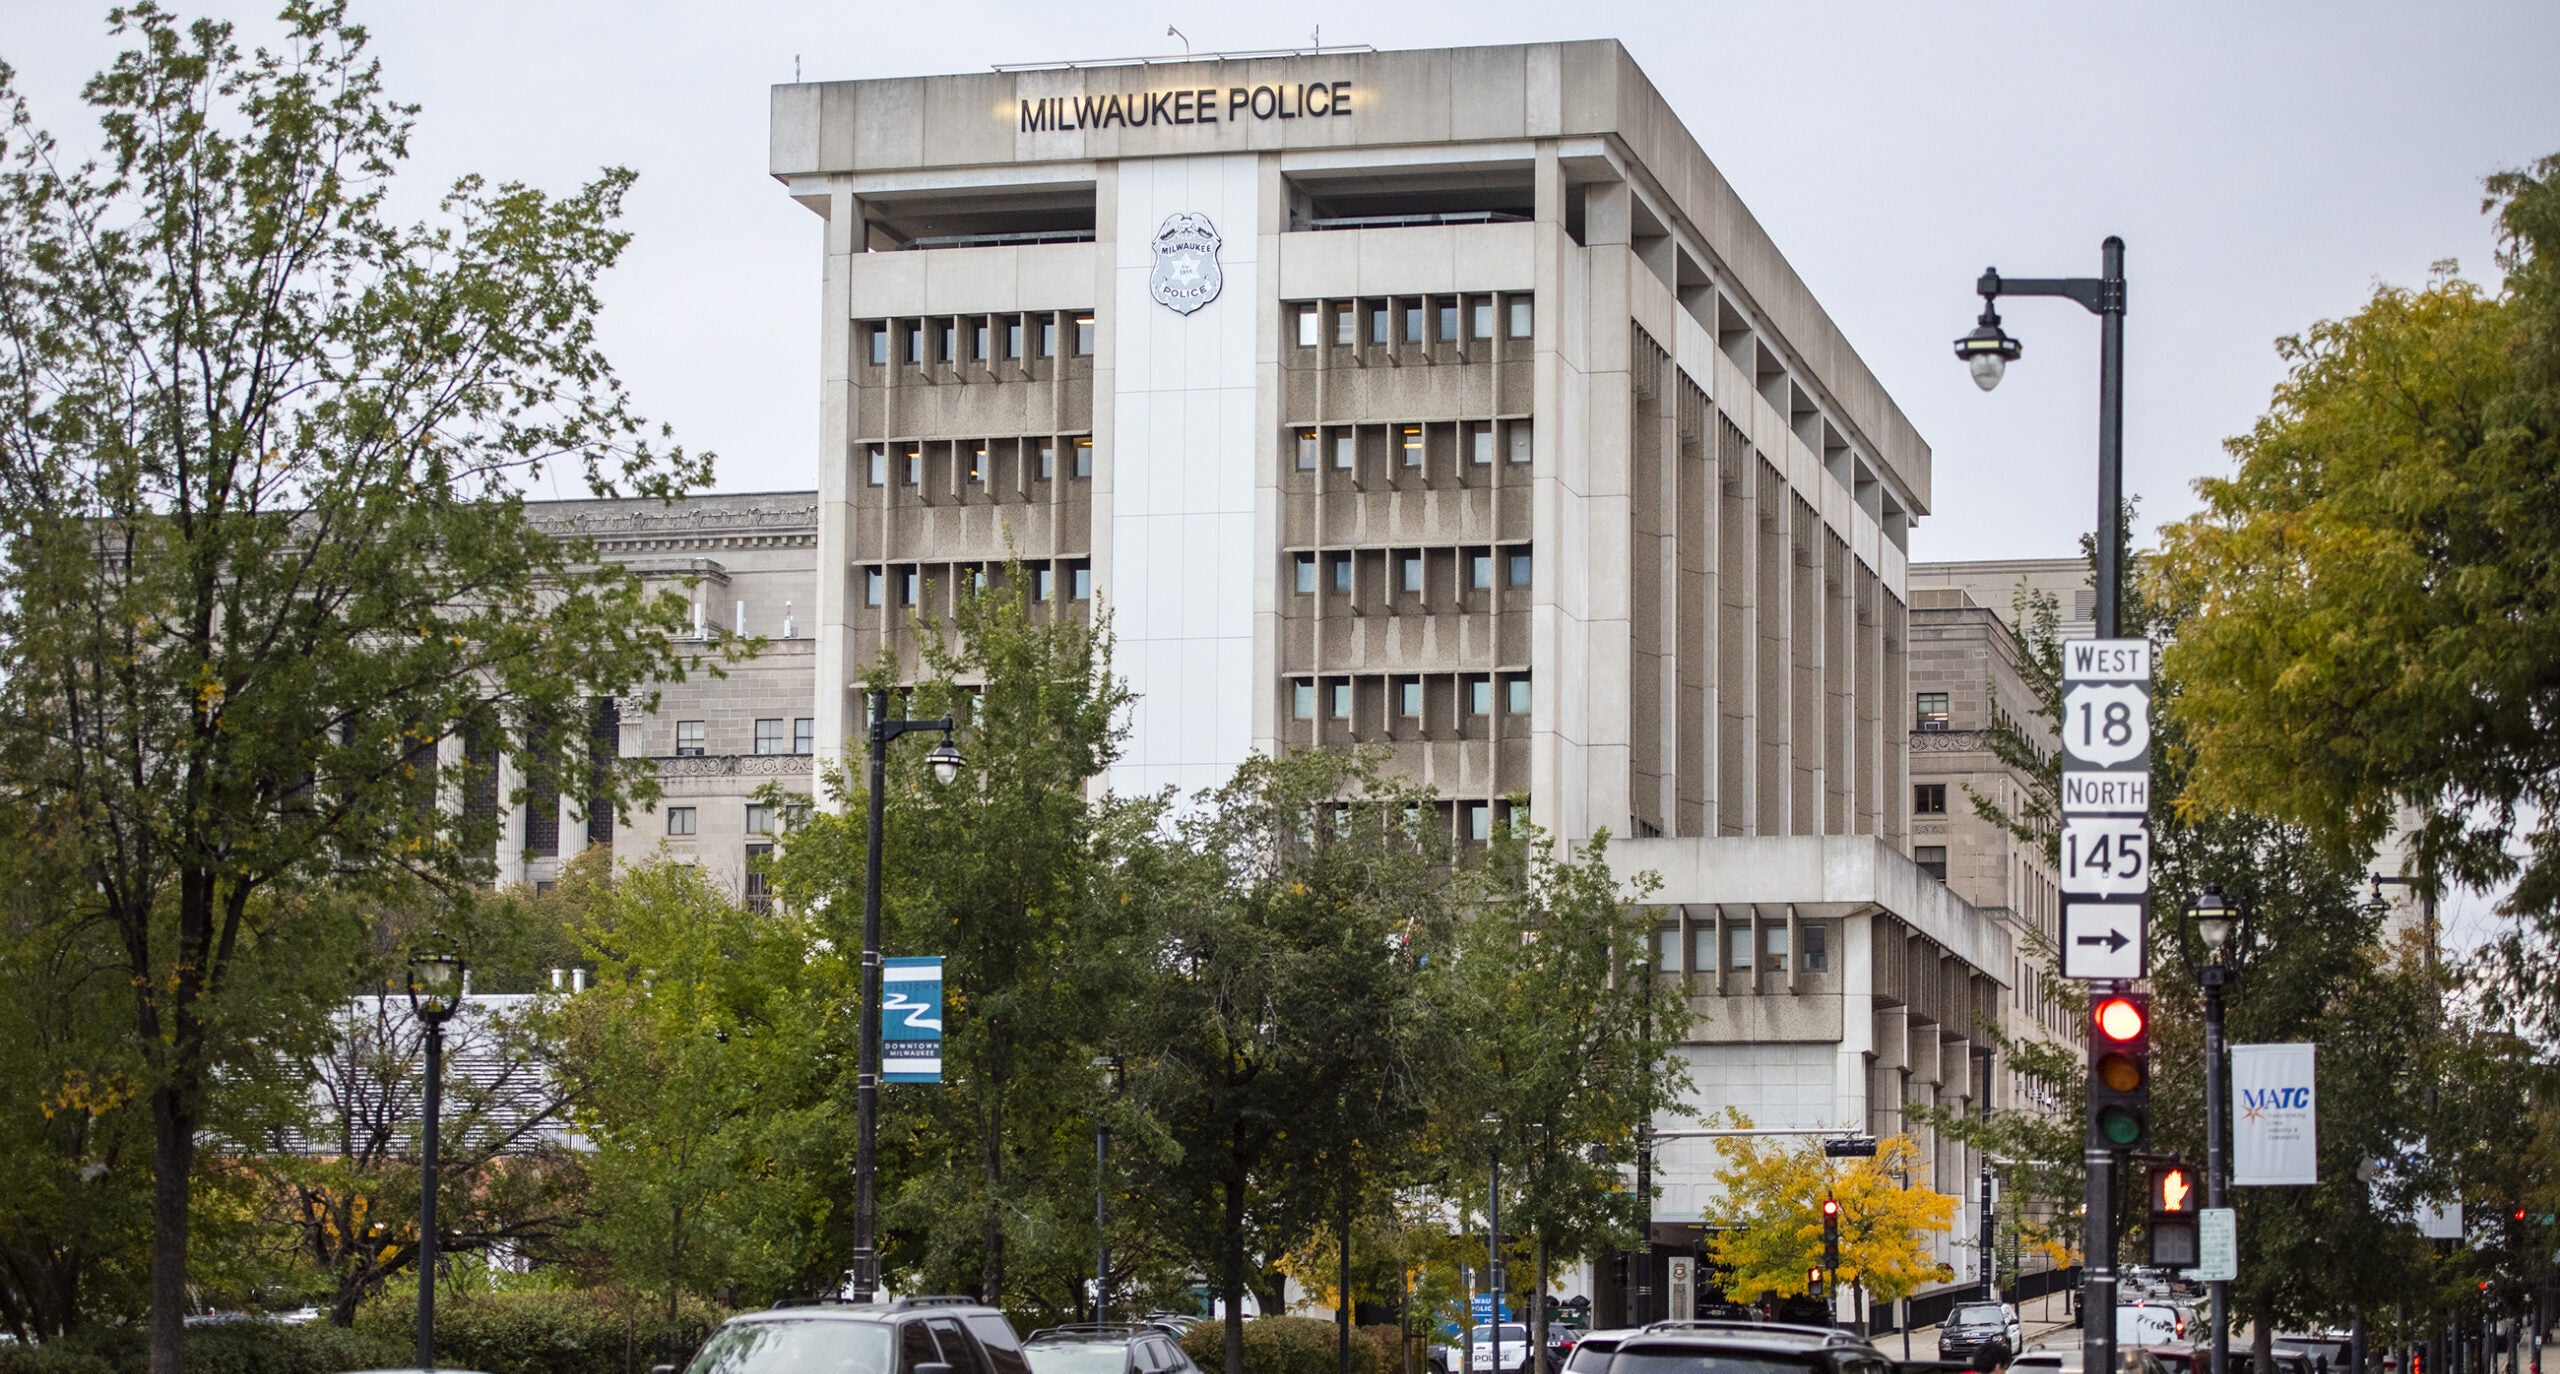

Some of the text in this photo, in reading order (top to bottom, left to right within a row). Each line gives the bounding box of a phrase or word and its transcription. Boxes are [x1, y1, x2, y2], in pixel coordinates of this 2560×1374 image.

[1020, 80, 1352, 133] MILWAUKEE POLICE
[1161, 242, 1212, 255] MILWAUKEE
[1163, 284, 1208, 298] POLICE
[2075, 645, 2141, 673] WEST
[2080, 701, 2133, 747] 18
[2066, 777, 2145, 805] NORTH
[2066, 833, 2143, 880] 145
[2241, 1087, 2310, 1109] MATC
[1474, 1354, 1511, 1362] POLCE
